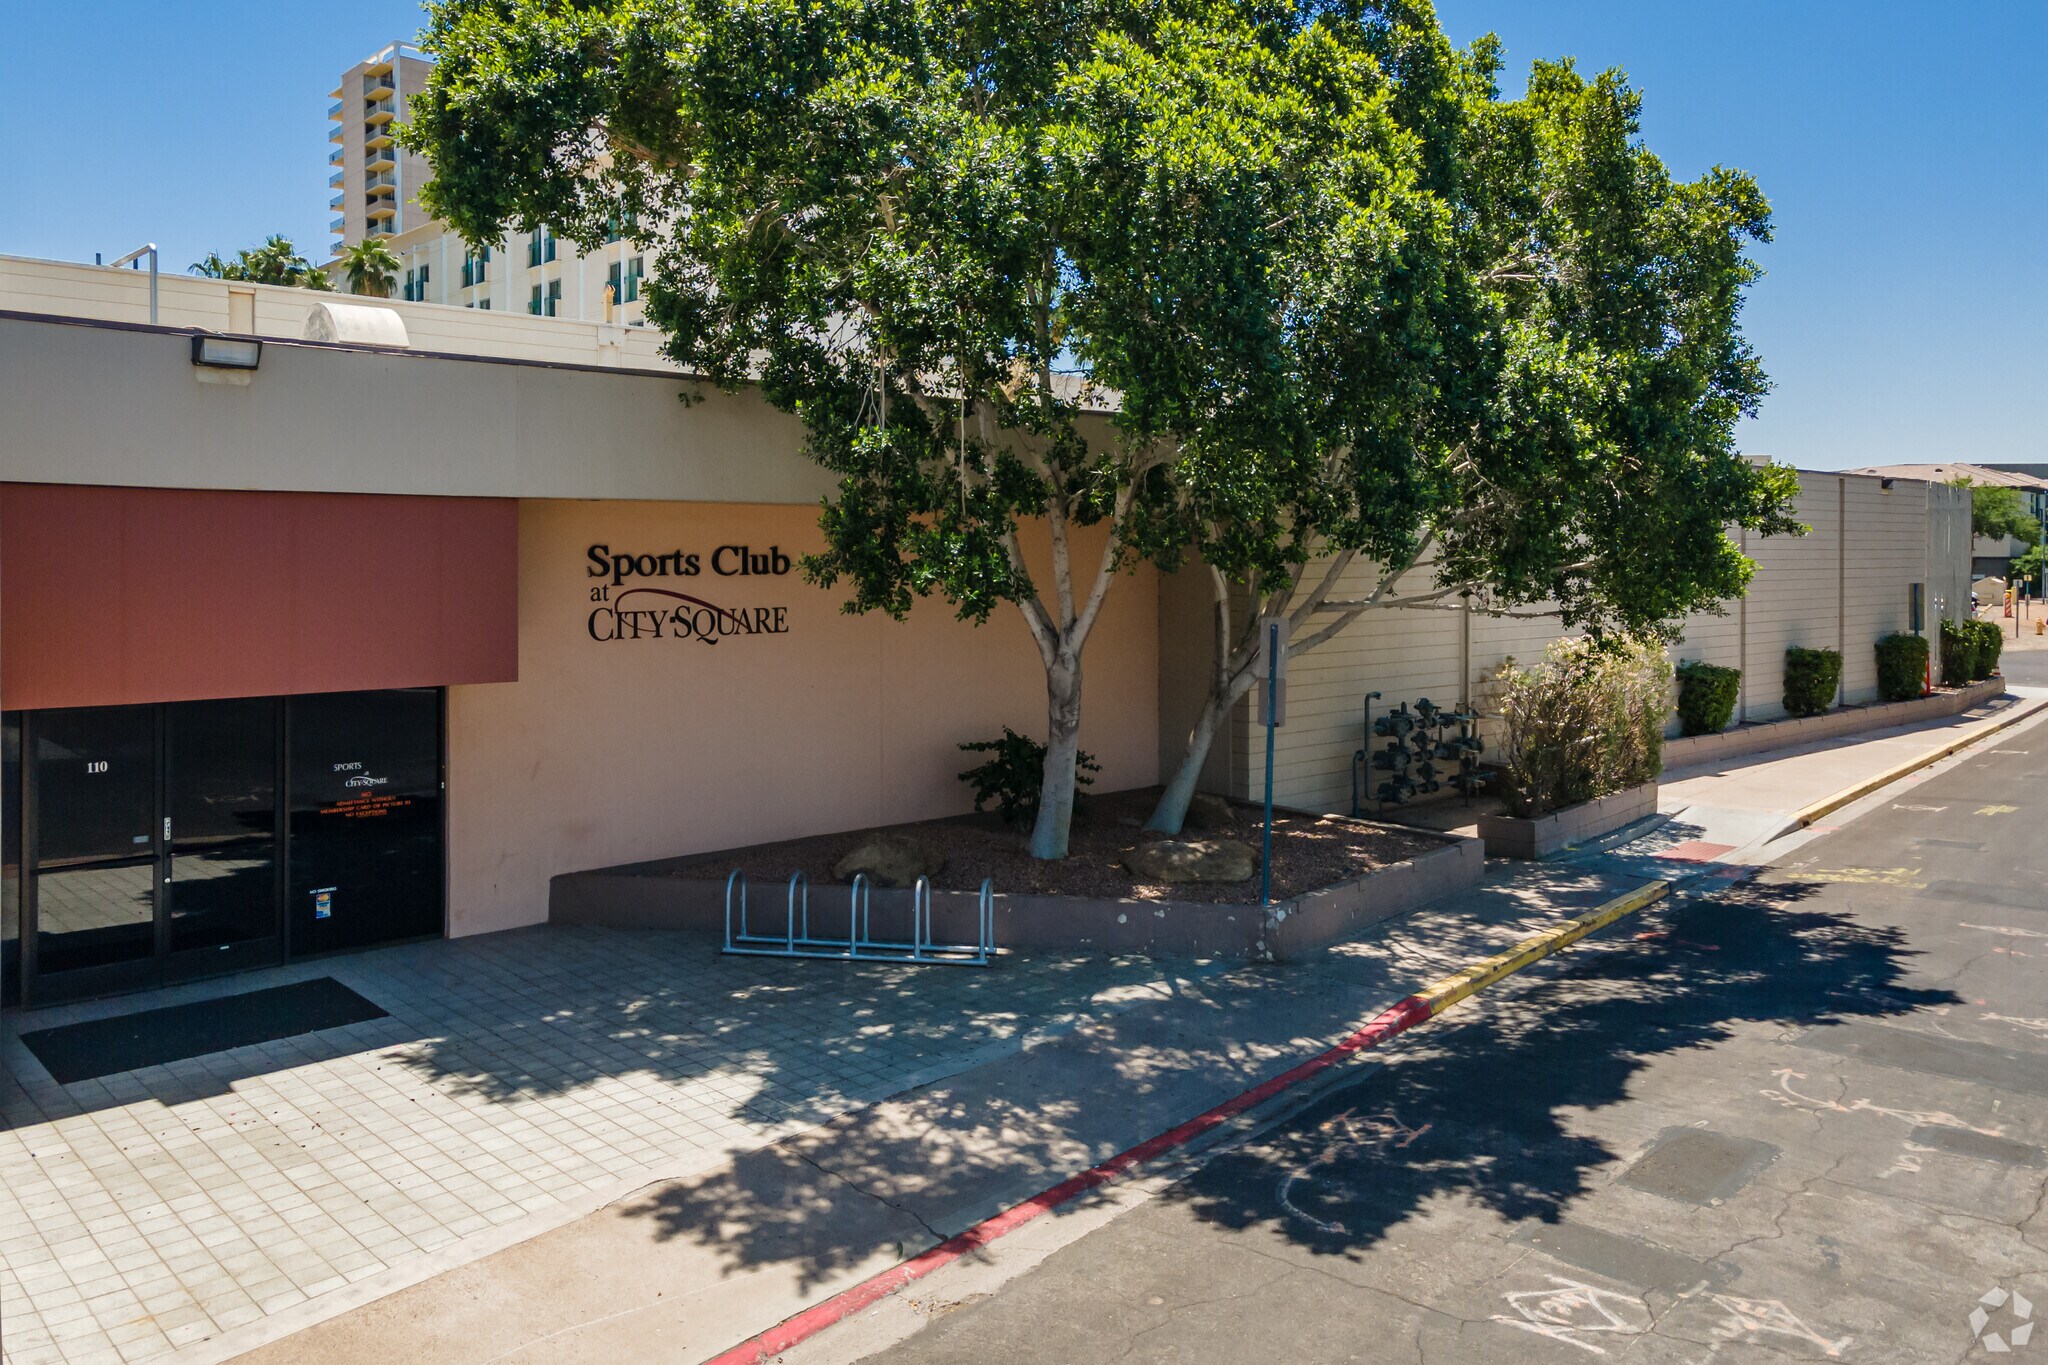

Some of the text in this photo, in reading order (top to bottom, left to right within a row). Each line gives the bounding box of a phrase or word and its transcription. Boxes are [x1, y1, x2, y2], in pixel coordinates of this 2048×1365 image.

[587, 544, 791, 586] Sports Club
[590, 583, 610, 602] at
[87, 760, 108, 774] 110
[333, 762, 362, 771] SPORTS
